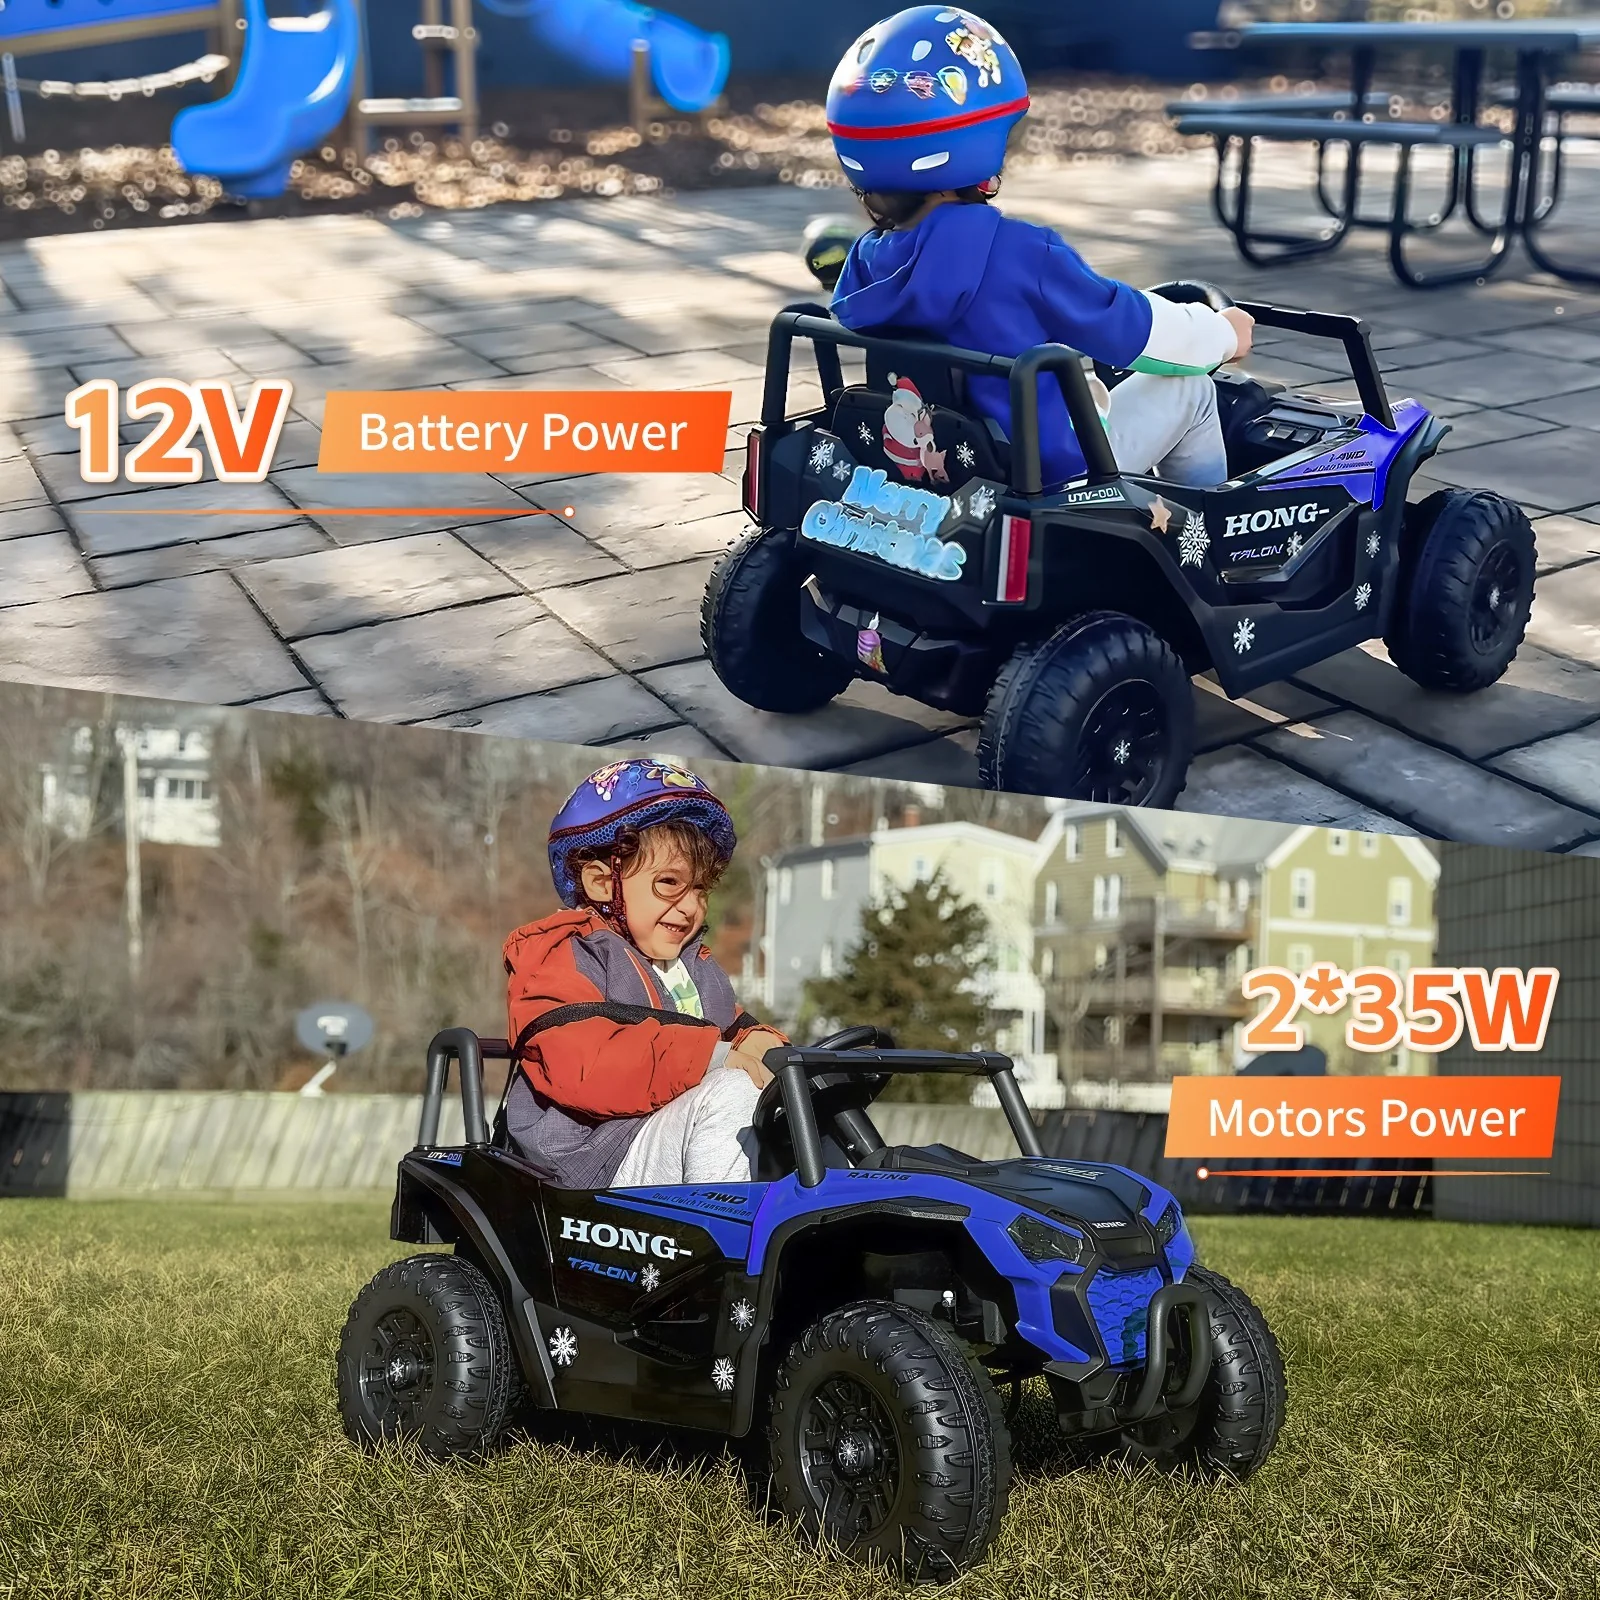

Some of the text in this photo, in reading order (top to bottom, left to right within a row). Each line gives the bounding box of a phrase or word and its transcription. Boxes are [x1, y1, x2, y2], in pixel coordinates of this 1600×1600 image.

[1223, 502, 1330, 537] HONG-
[1229, 543, 1285, 562] TALON
[846, 1171, 912, 1181] RACING
[652, 1192, 753, 1218] Dual Clutch Transmission
[560, 1216, 693, 1261] HONG-
[567, 1255, 638, 1283] TALON
